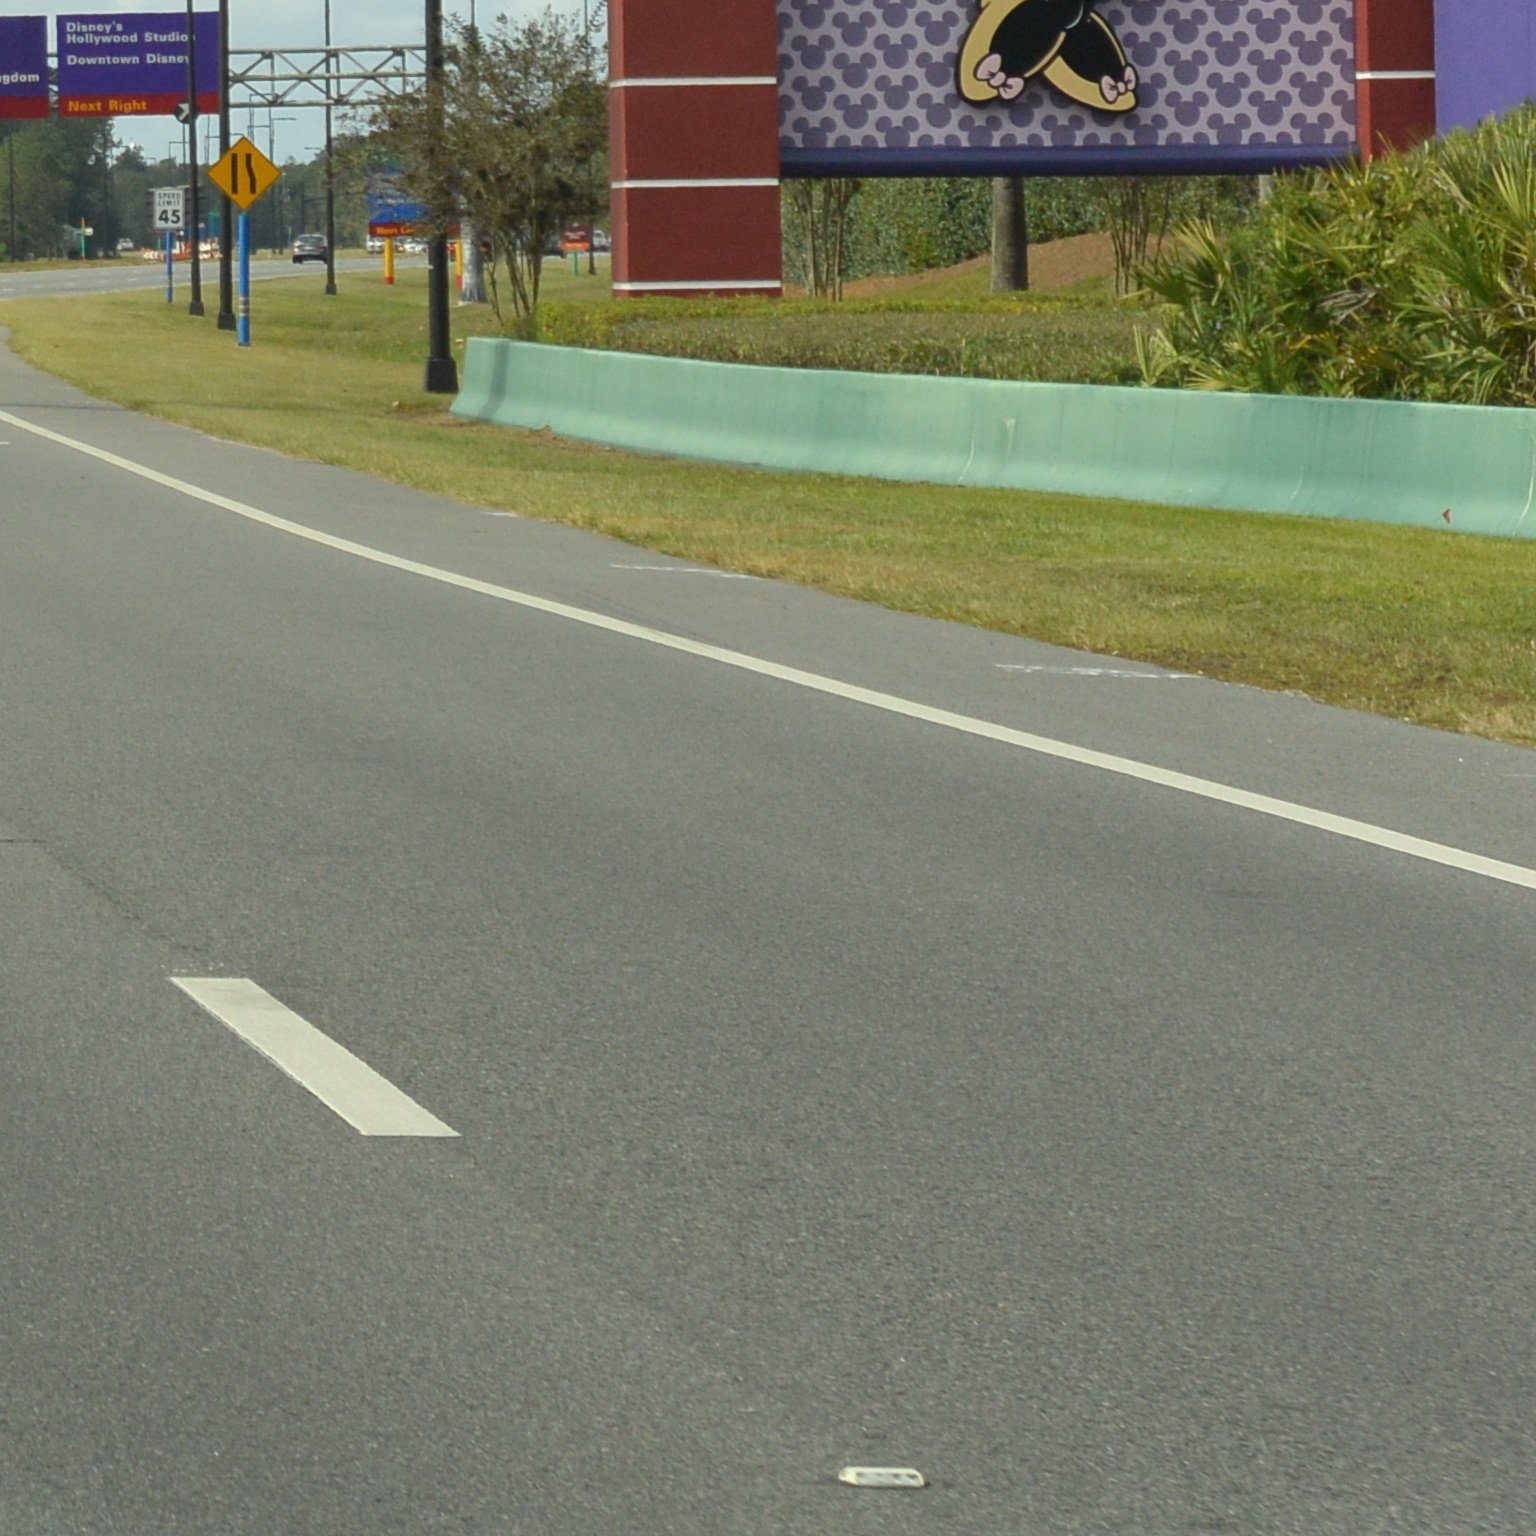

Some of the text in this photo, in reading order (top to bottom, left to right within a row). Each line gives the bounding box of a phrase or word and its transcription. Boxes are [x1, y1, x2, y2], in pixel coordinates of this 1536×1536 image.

[66, 21, 123, 34] Disney's
[66, 33, 138, 45] Hollywood
[67, 54, 140, 65] Downtown
[68, 99, 147, 113] Next Right
[158, 192, 181, 200] SPEED
[158, 209, 181, 224] 45
